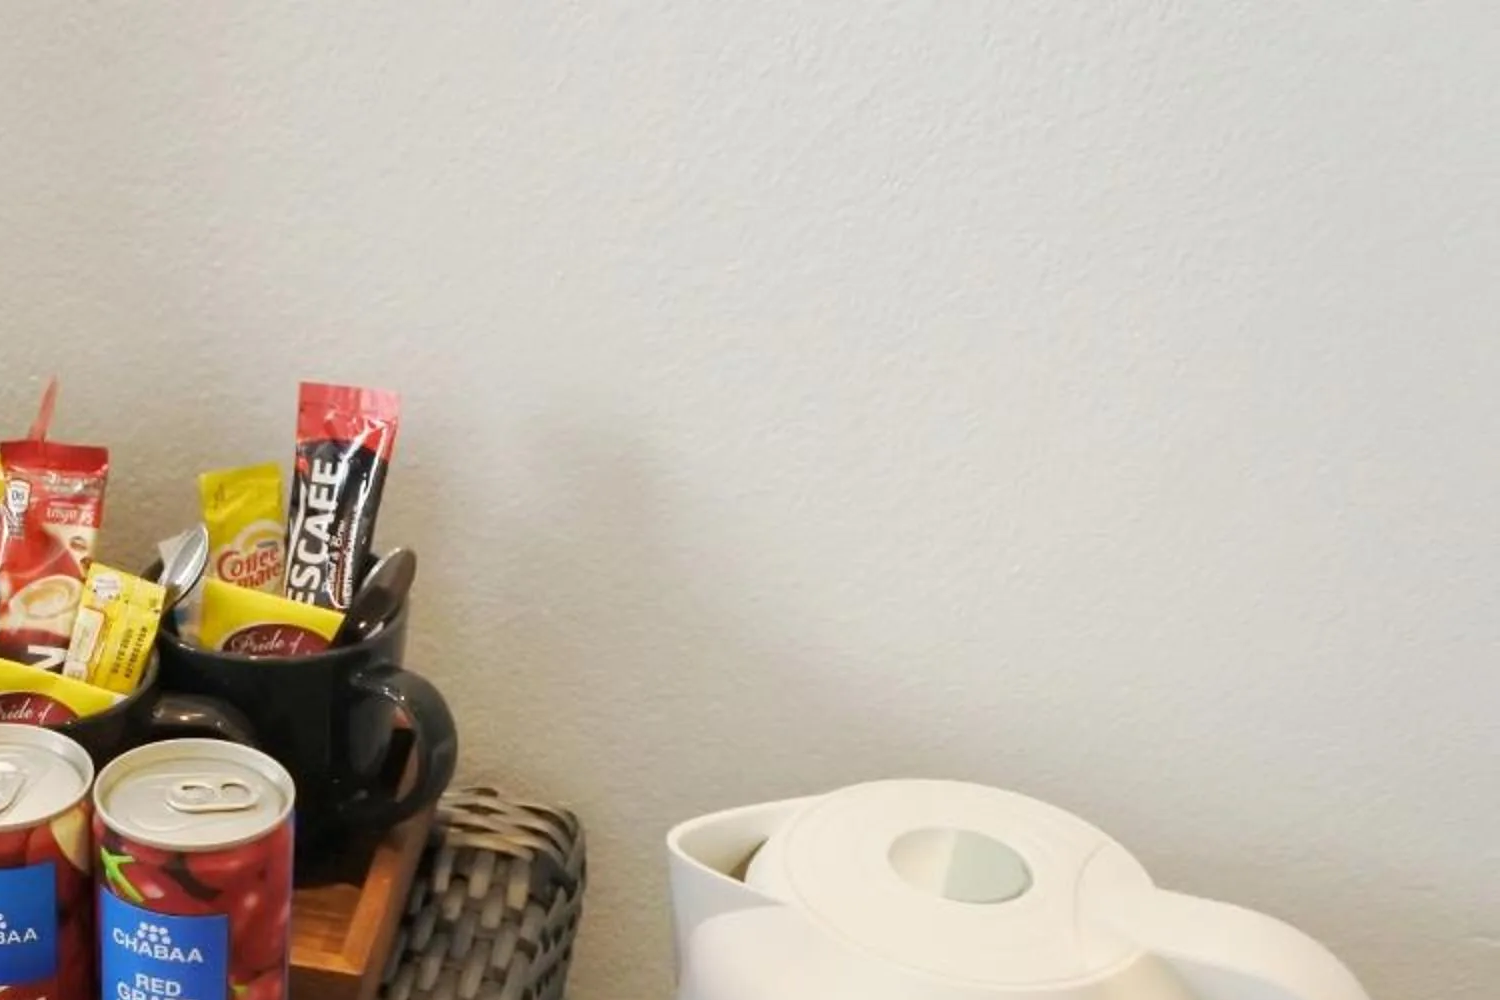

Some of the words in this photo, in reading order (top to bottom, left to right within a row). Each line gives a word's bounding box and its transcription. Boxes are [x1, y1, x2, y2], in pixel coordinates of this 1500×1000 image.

[287, 458, 342, 607] ESCAFE
[113, 928, 204, 963] CHABAA
[135, 973, 181, 997] RED
